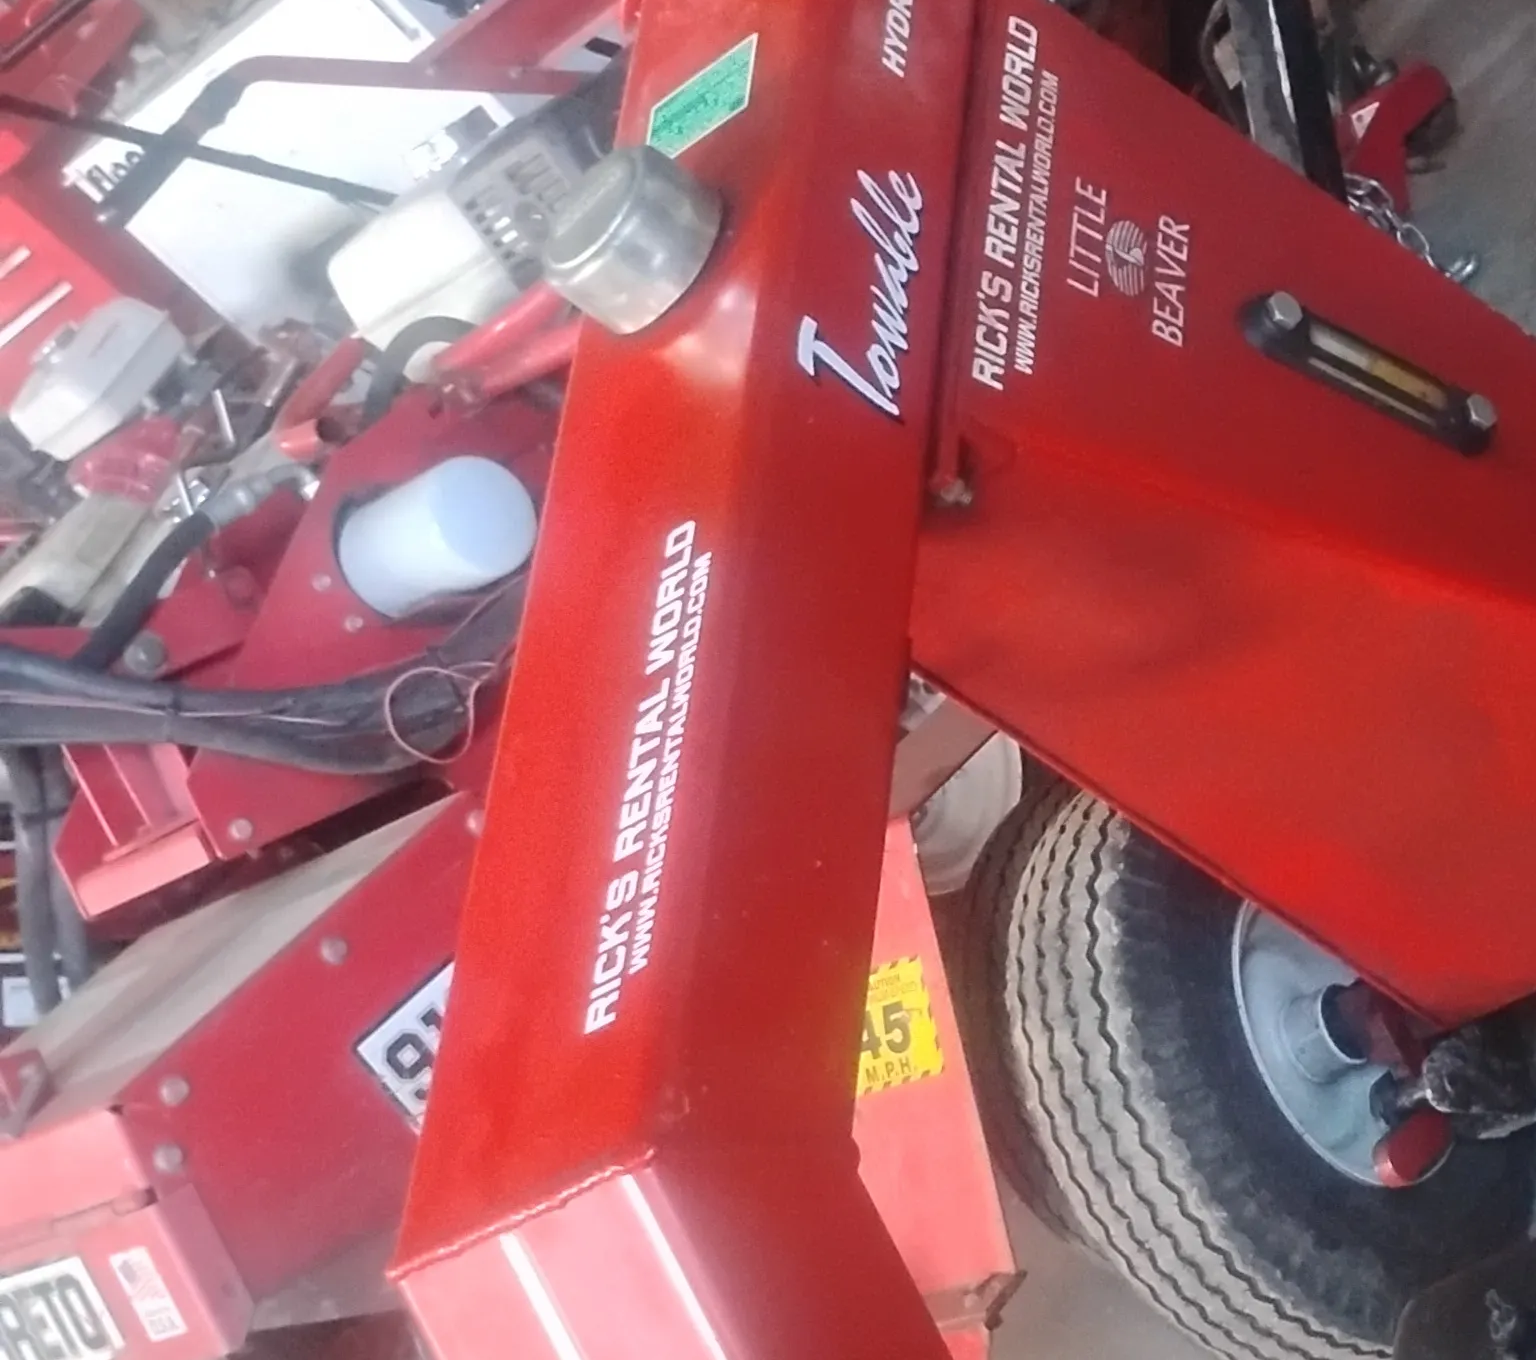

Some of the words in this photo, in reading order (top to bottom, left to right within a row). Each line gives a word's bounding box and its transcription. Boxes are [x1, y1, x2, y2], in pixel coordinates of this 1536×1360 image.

[999, 15, 1038, 132] WORLD
[984, 139, 1027, 269] RENTAL
[1014, 69, 1059, 375] WWW.RICKSRENTALWORLD.COM
[1066, 176, 1107, 298] LITTLE
[798, 169, 923, 416] Towable
[972, 270, 1013, 391] RICK'S
[1151, 214, 1190, 348] BEAVER
[584, 869, 640, 1035] RICK'S
[613, 677, 671, 863] RENTAL
[645, 520, 697, 676] WORLD
[628, 551, 712, 975] WWW.RICKSRENTALWORLD.COM
